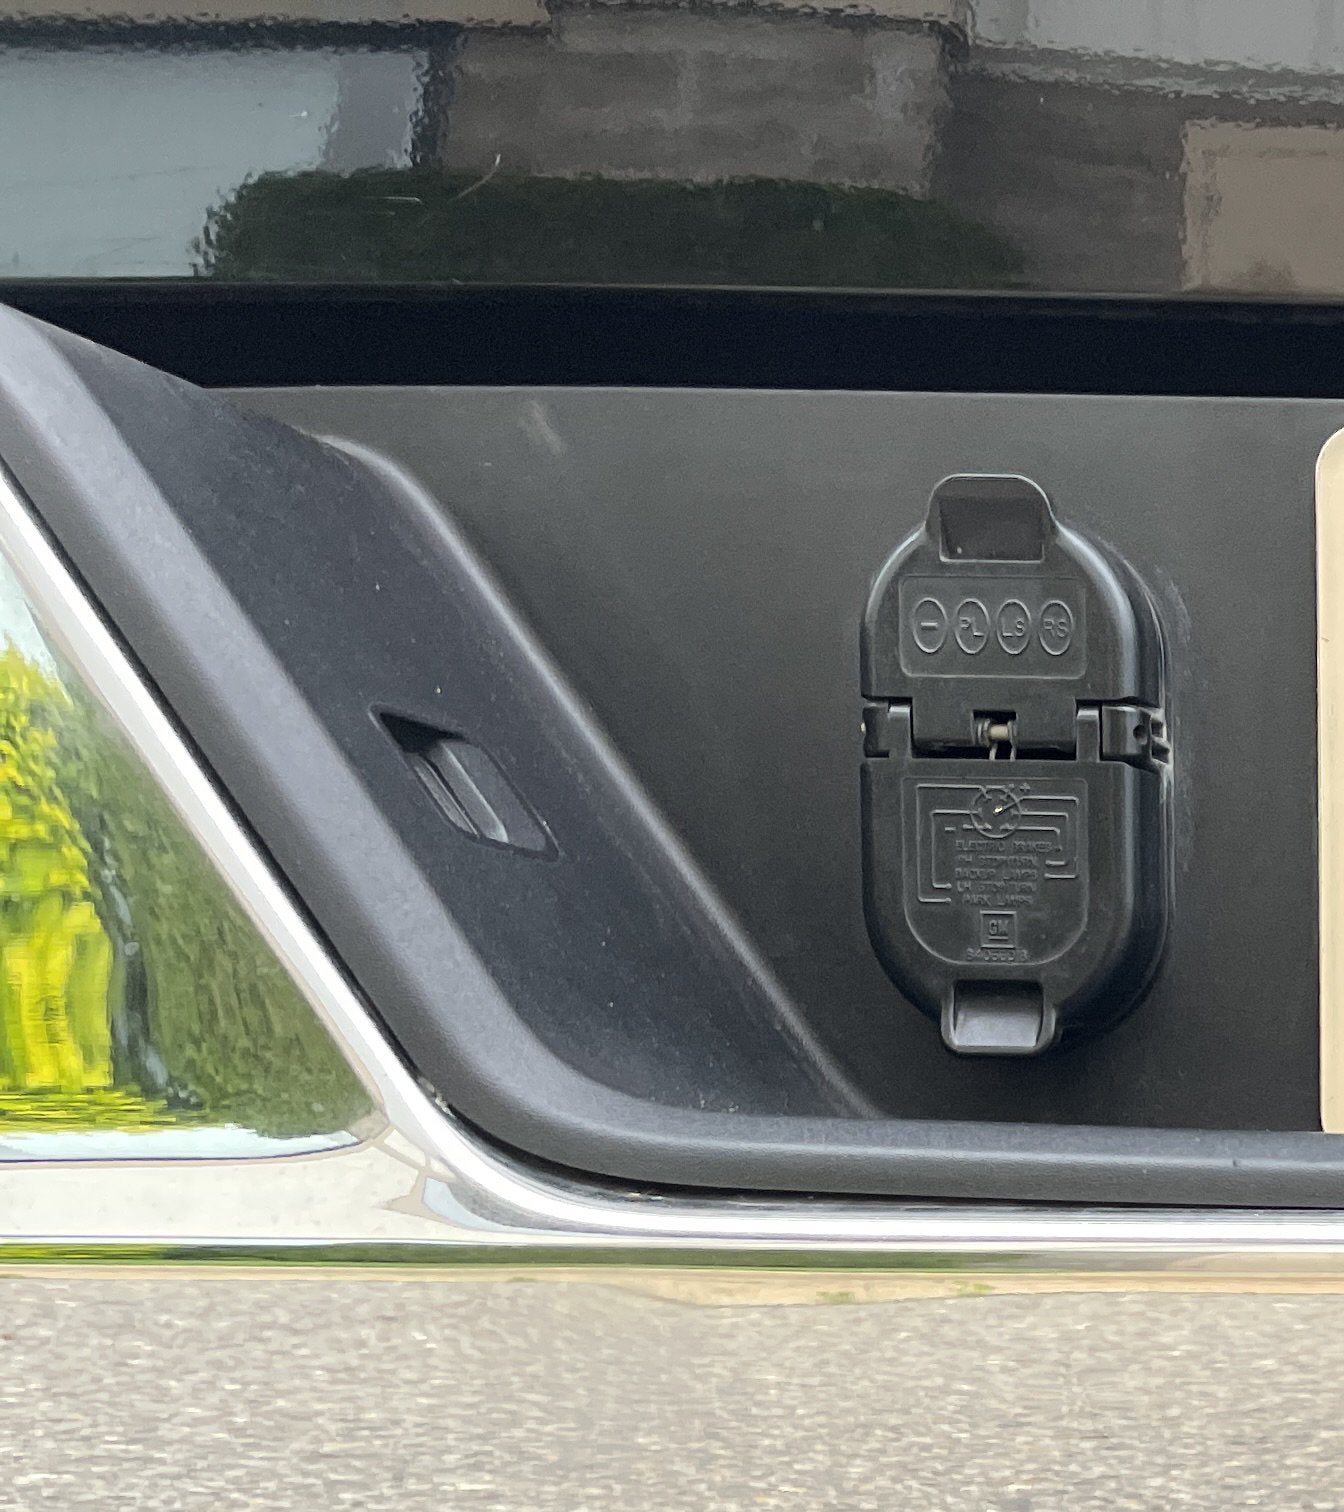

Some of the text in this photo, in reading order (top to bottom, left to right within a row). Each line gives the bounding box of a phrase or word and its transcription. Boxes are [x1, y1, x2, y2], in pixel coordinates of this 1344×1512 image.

[959, 616, 985, 637] PL
[1002, 616, 1026, 637] LS
[1043, 618, 1069, 638] RS
